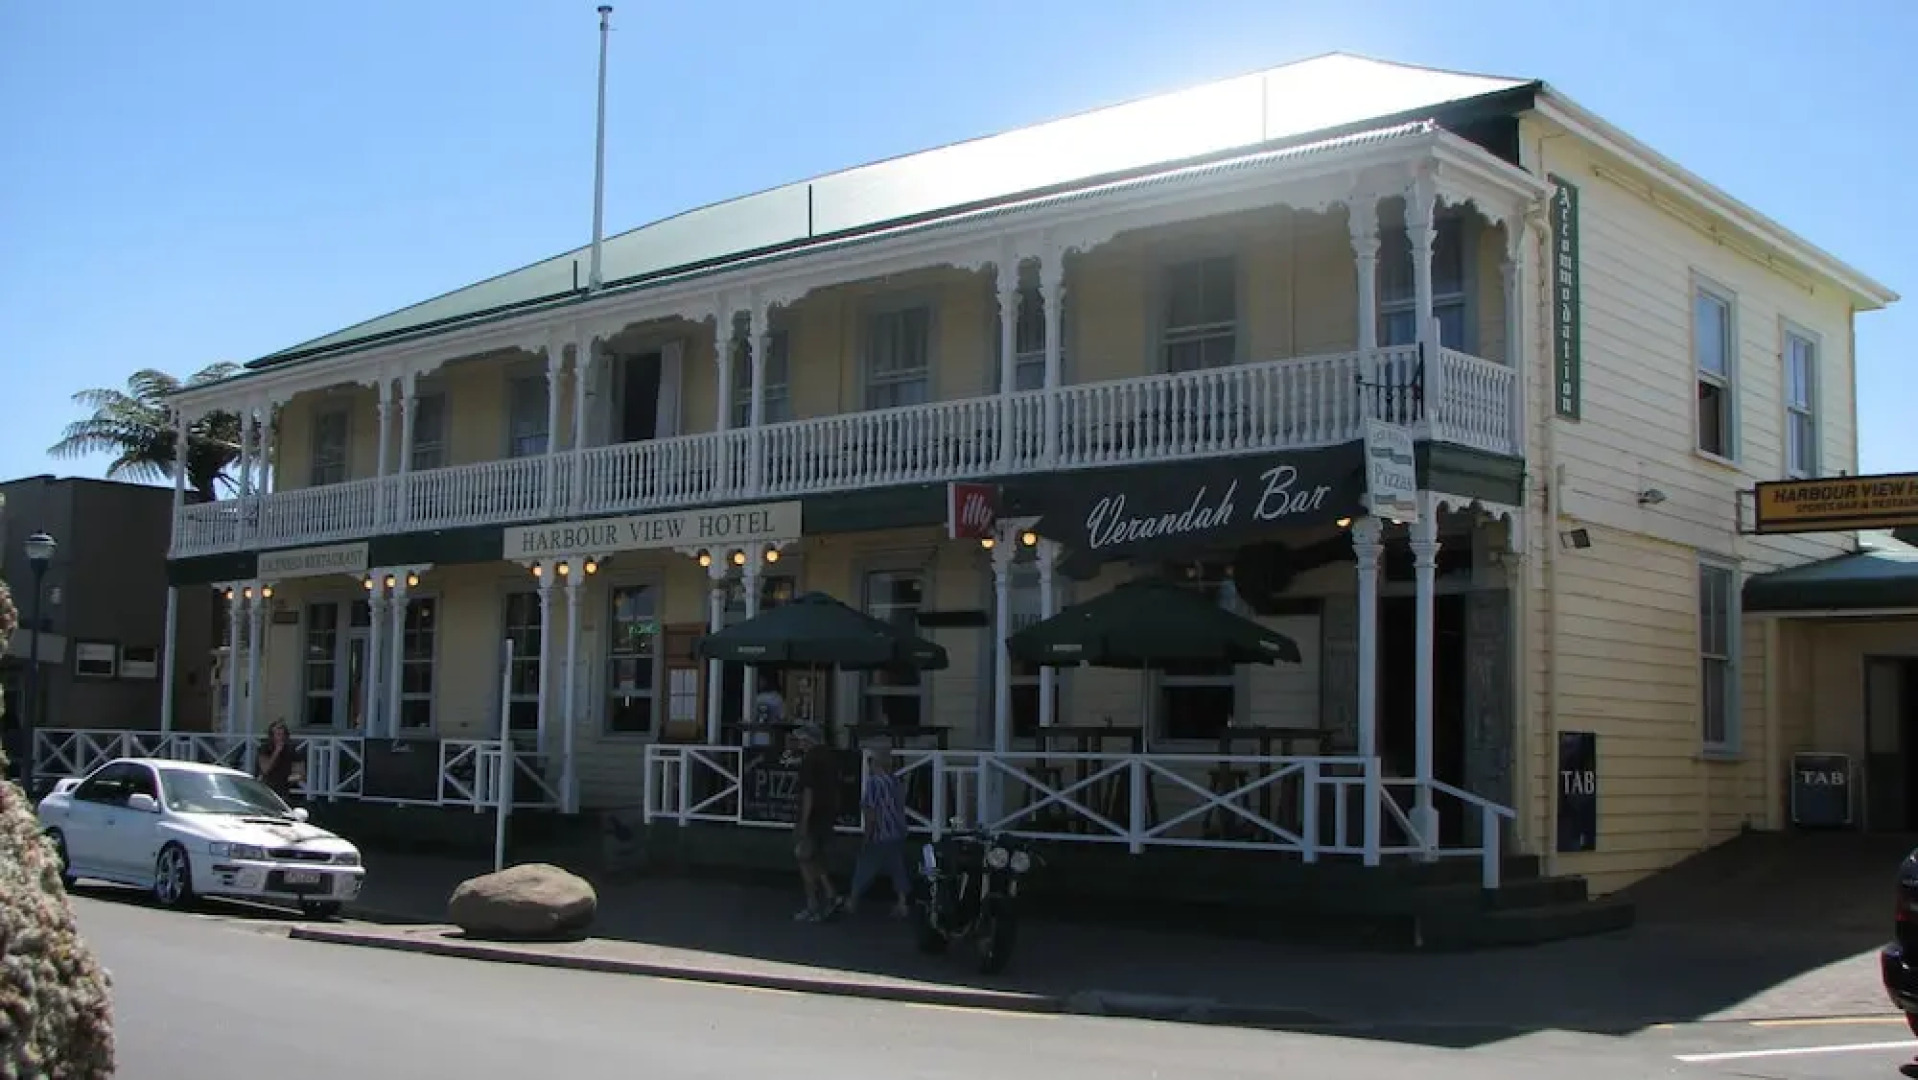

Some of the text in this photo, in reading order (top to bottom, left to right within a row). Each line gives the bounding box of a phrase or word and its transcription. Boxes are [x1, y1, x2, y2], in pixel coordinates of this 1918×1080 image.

[1558, 187, 1572, 413] Accommodation
[1086, 465, 1332, 549] Verandah Bar
[1773, 484, 1858, 503] HARBOUR
[1861, 480, 1906, 498] VIEW
[962, 492, 993, 533] illy
[522, 510, 776, 552] HARBOUR VIEW HOTEL
[755, 769, 799, 798] PIZZ
[1561, 770, 1595, 795] TAB
[1799, 770, 1845, 785] TAB
